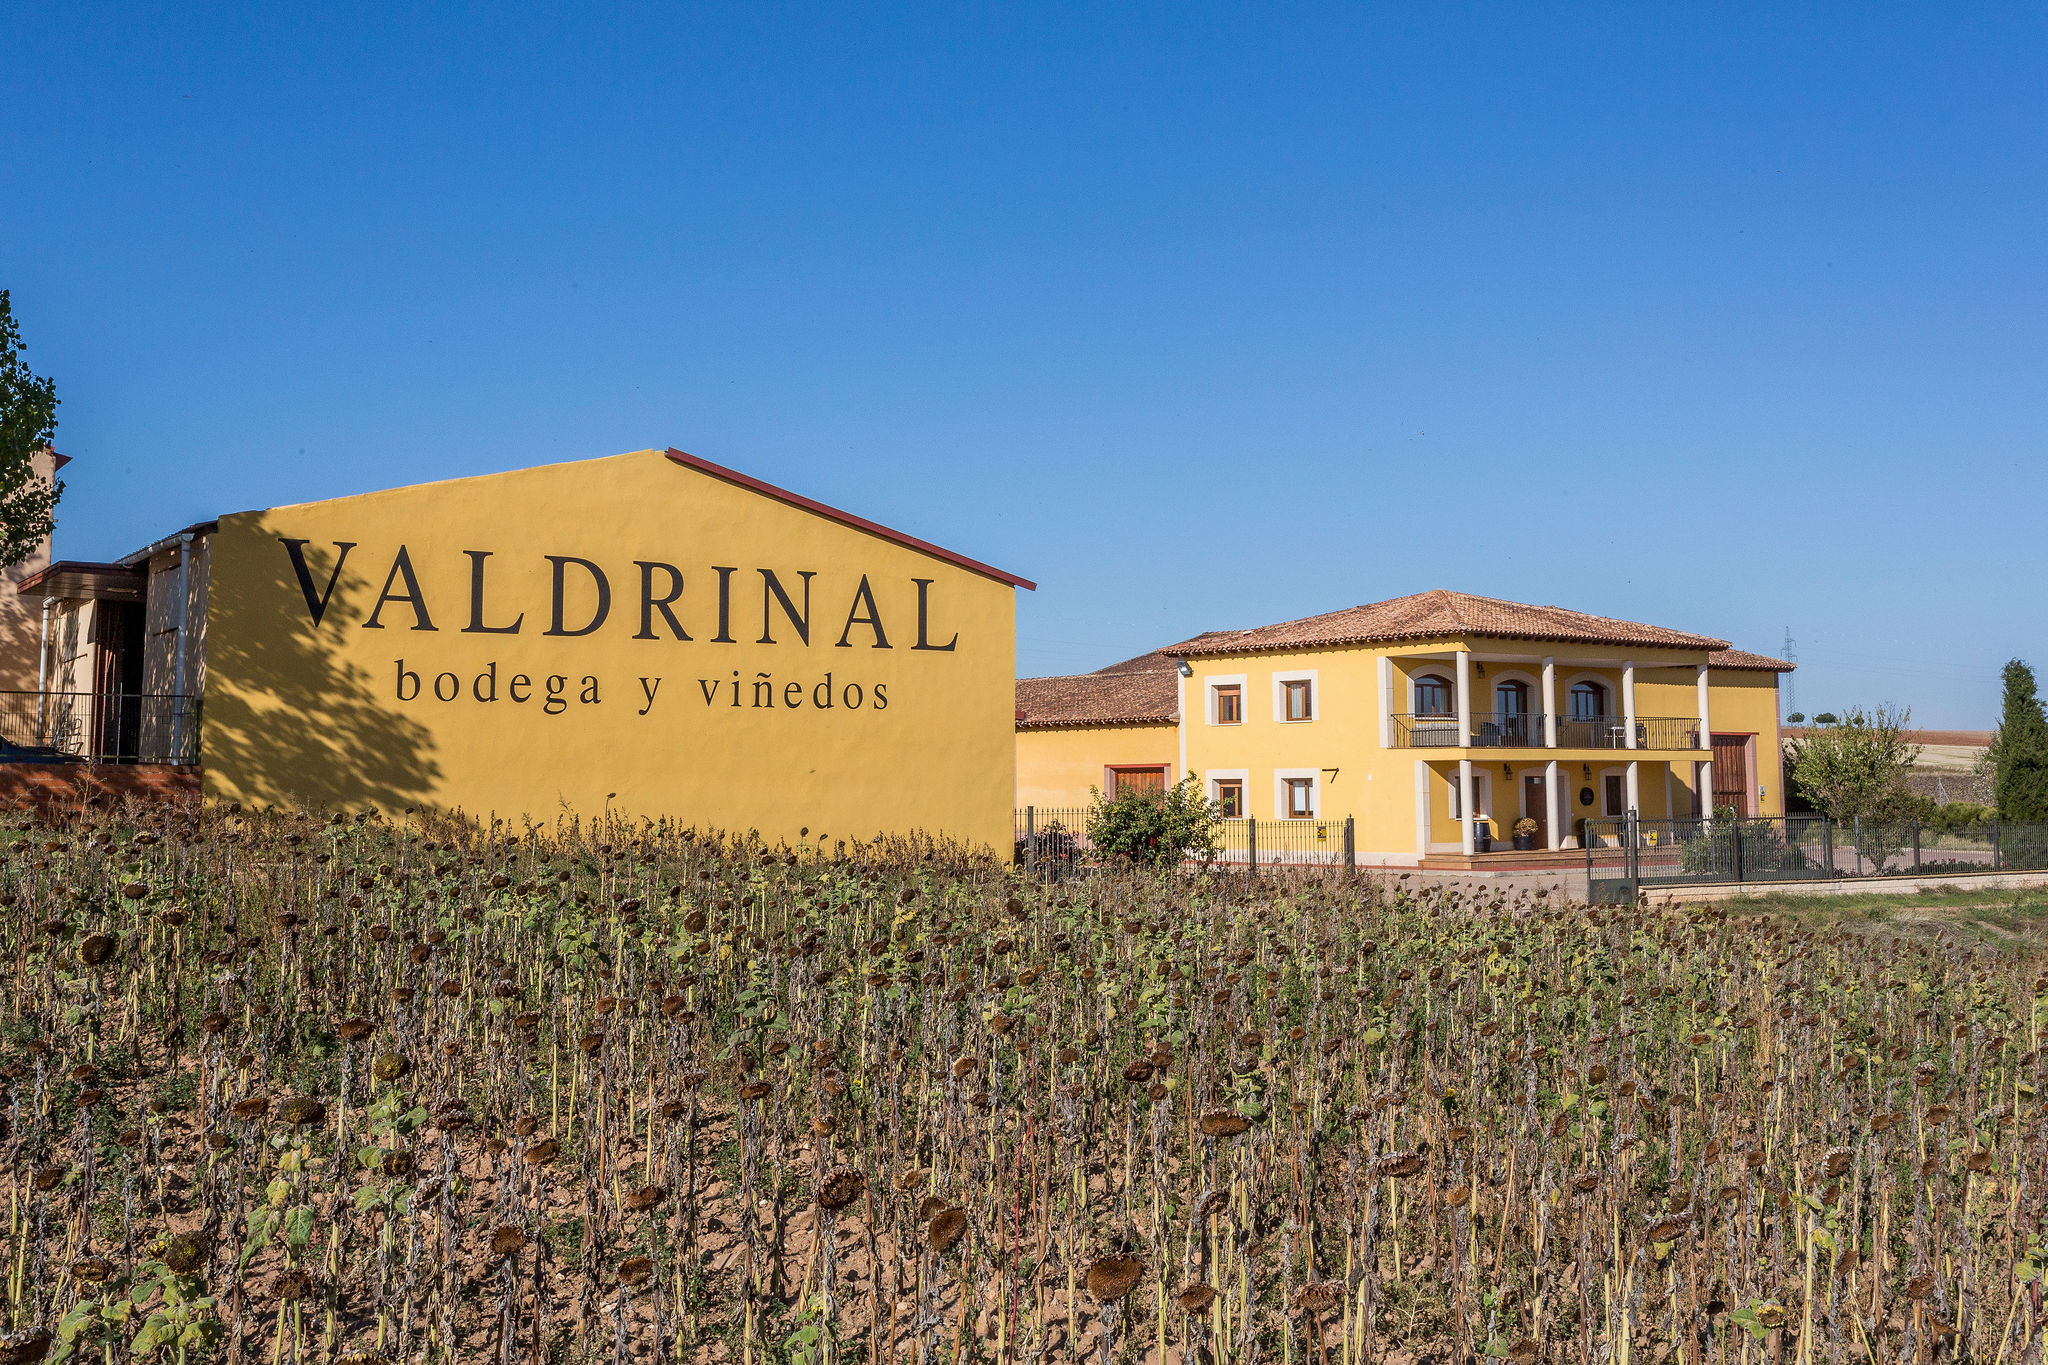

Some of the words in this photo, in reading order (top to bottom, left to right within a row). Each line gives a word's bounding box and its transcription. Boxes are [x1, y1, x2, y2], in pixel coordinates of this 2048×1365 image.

[278, 538, 959, 652] VALDRINAL
[394, 659, 602, 715] bodega
[638, 677, 663, 716] y
[697, 670, 889, 710] viñedos
